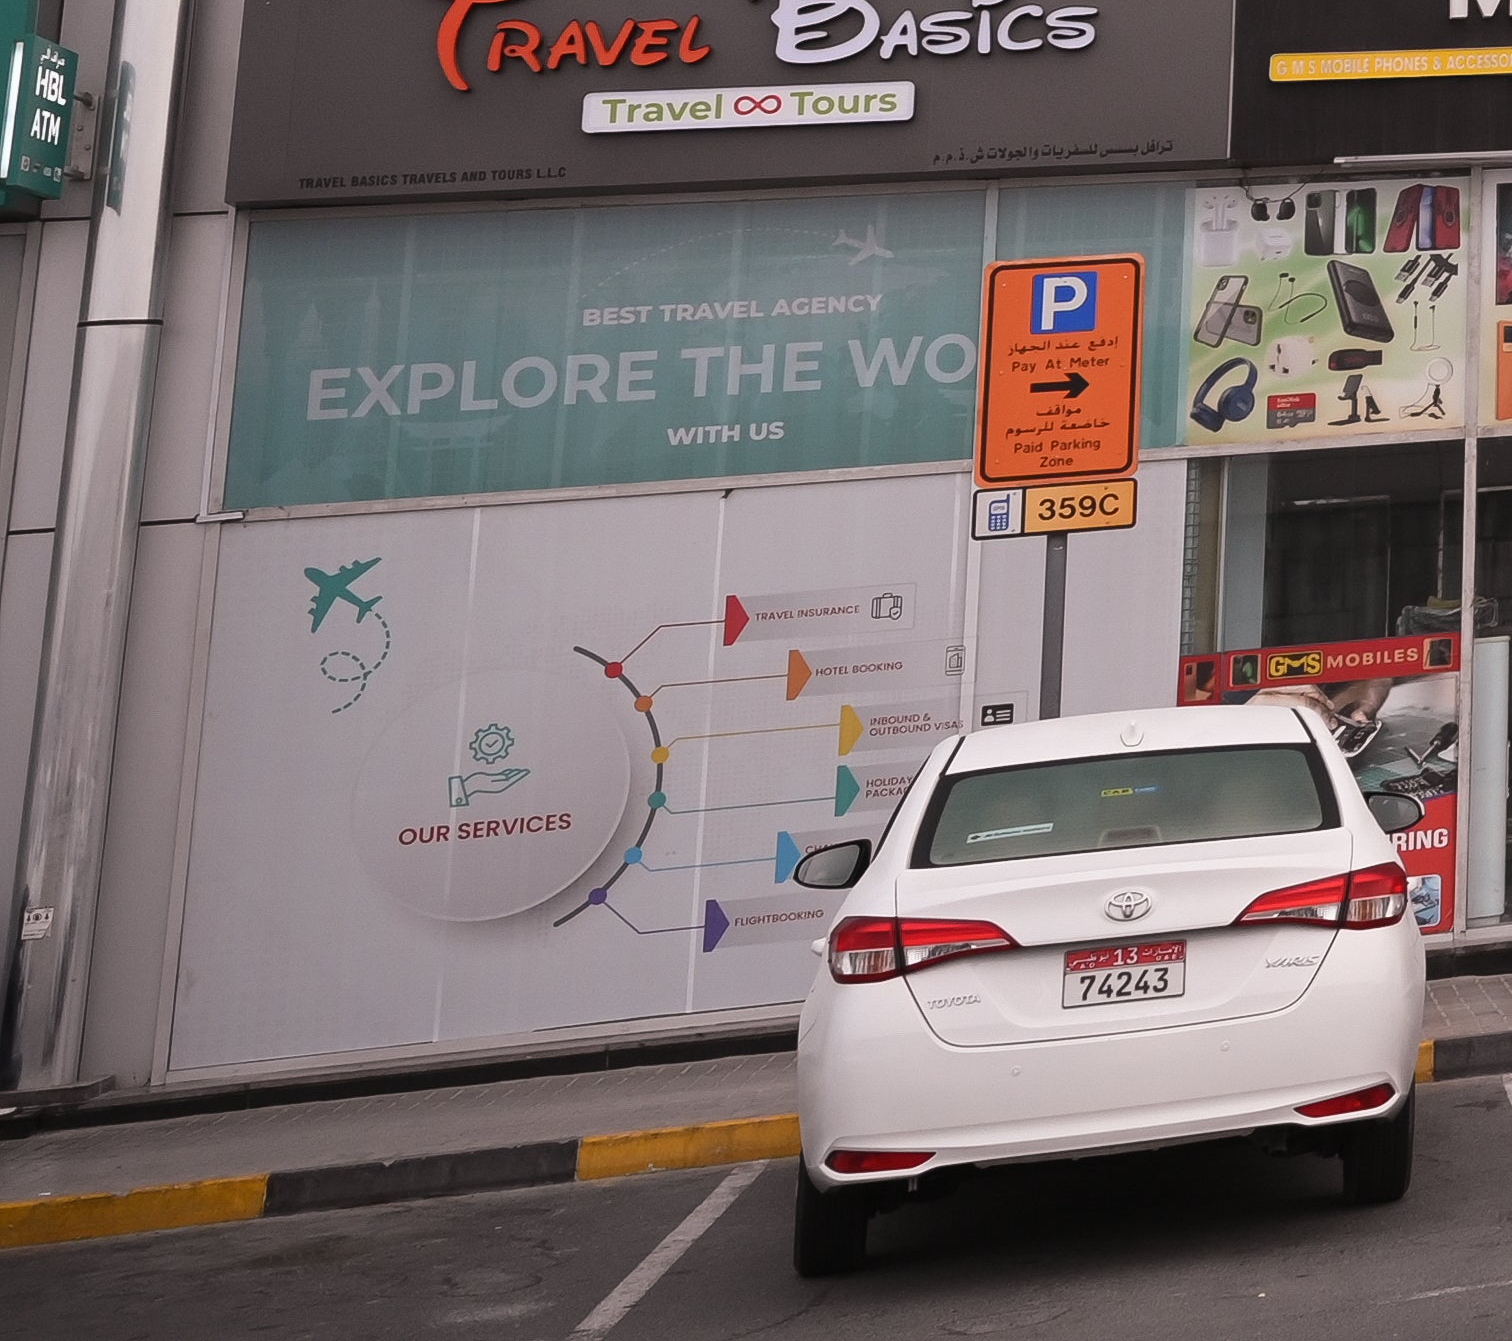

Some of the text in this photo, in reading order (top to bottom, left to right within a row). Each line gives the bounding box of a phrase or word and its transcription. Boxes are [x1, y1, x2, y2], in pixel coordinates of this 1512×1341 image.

[1319, 57, 1371, 75] MOBILE
[1373, 55, 1430, 73] PHONES
[34, 65, 69, 107] HBL
[601, 86, 901, 127] Travel Tours
[29, 107, 62, 148] ATM
[298, 167, 533, 190] TRAVEL BASICS TRAVELS AND TOURS
[581, 292, 885, 330] BEST TRAVEL AGENCY
[1039, 274, 1089, 332] P
[1011, 355, 1111, 374] Pay At Meter
[305, 339, 827, 423] EXPLORE THE
[665, 419, 787, 448] WITH US
[1013, 438, 1103, 455] Paid Parking
[1039, 455, 1075, 469] Zone
[1037, 491, 1121, 522] 359C
[754, 604, 862, 622] TRAVEL INSURANCE
[814, 660, 905, 678] HOTEL BOOKING
[1325, 646, 1421, 670] MOBILES
[868, 719, 966, 738] OUTBOUND VISAS
[869, 713, 921, 727] INBOUND
[865, 775, 914, 789] HOLIDAY
[397, 811, 574, 849] OUR SERVICES
[1112, 946, 1139, 967] 13
[1079, 966, 1170, 1002] 74243
[926, 991, 983, 1012] TOYOTA
